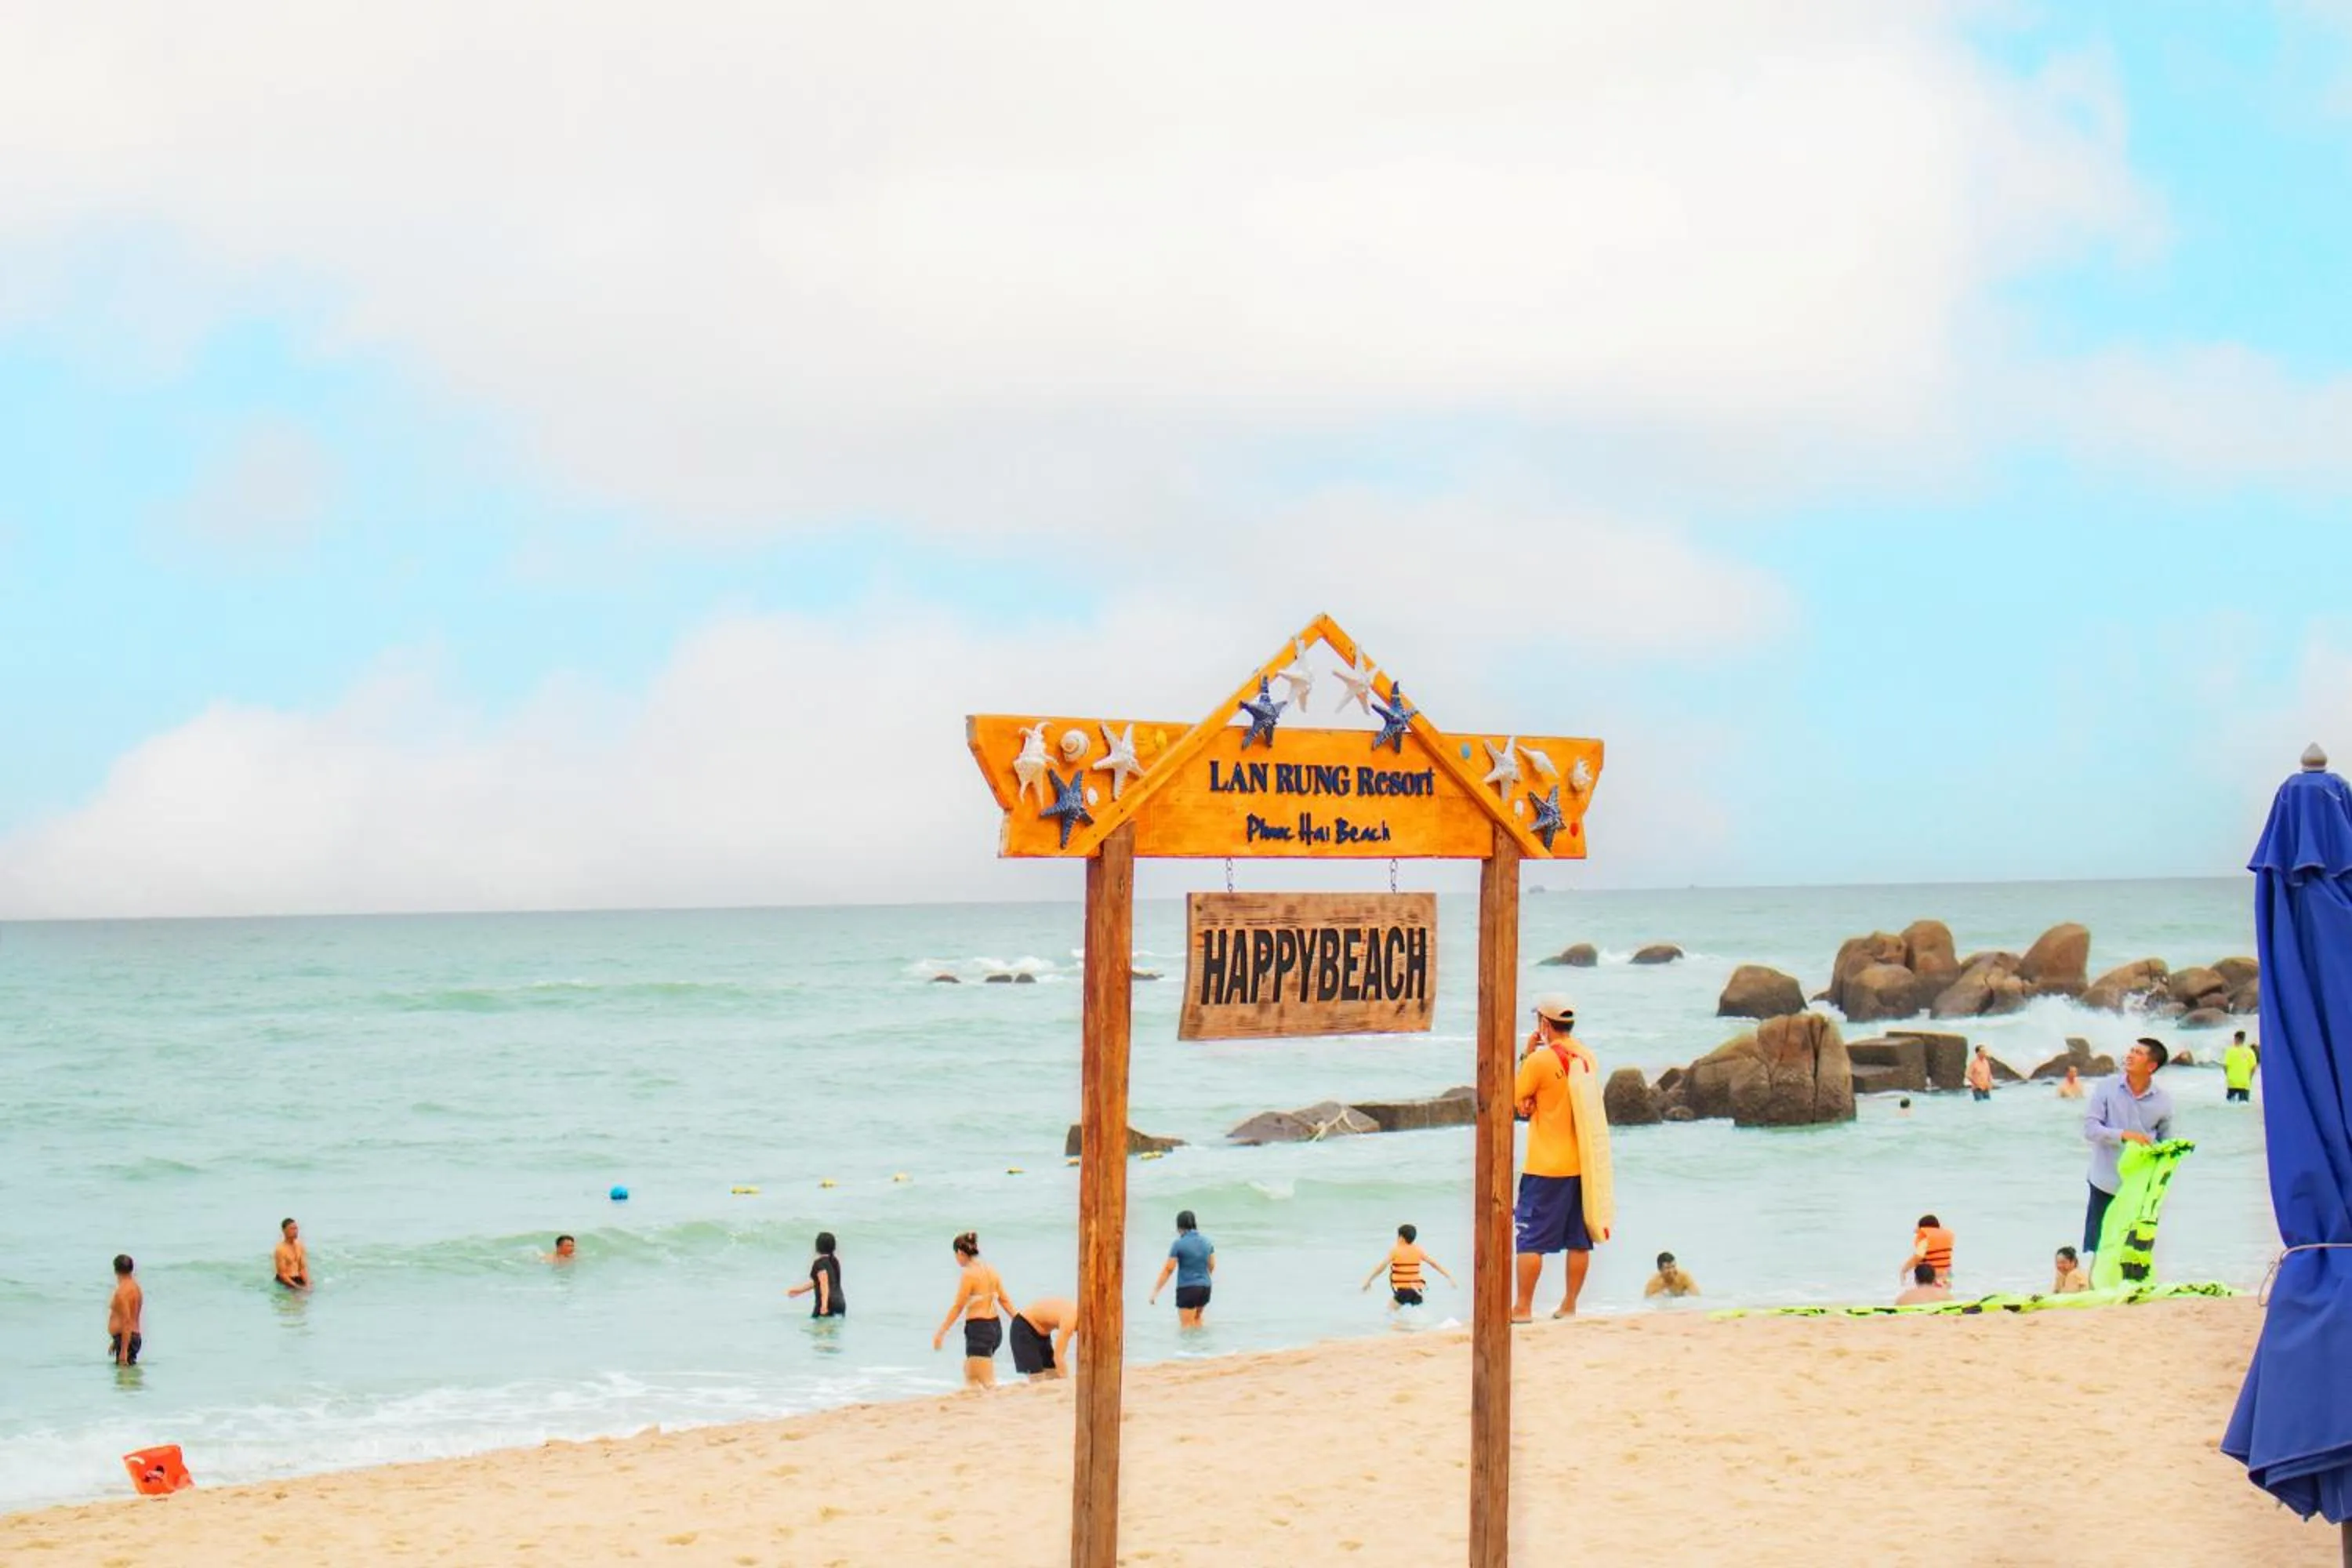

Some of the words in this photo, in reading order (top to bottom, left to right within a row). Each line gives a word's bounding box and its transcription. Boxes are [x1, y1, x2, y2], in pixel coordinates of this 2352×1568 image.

[1209, 760, 1268, 793] LAN
[1275, 763, 1351, 797] RUNG
[1356, 766, 1436, 797] Resort
[1298, 812, 1330, 845] Hai
[1334, 817, 1391, 844] Beach
[1200, 927, 1427, 1005] HAPPYBEACH
